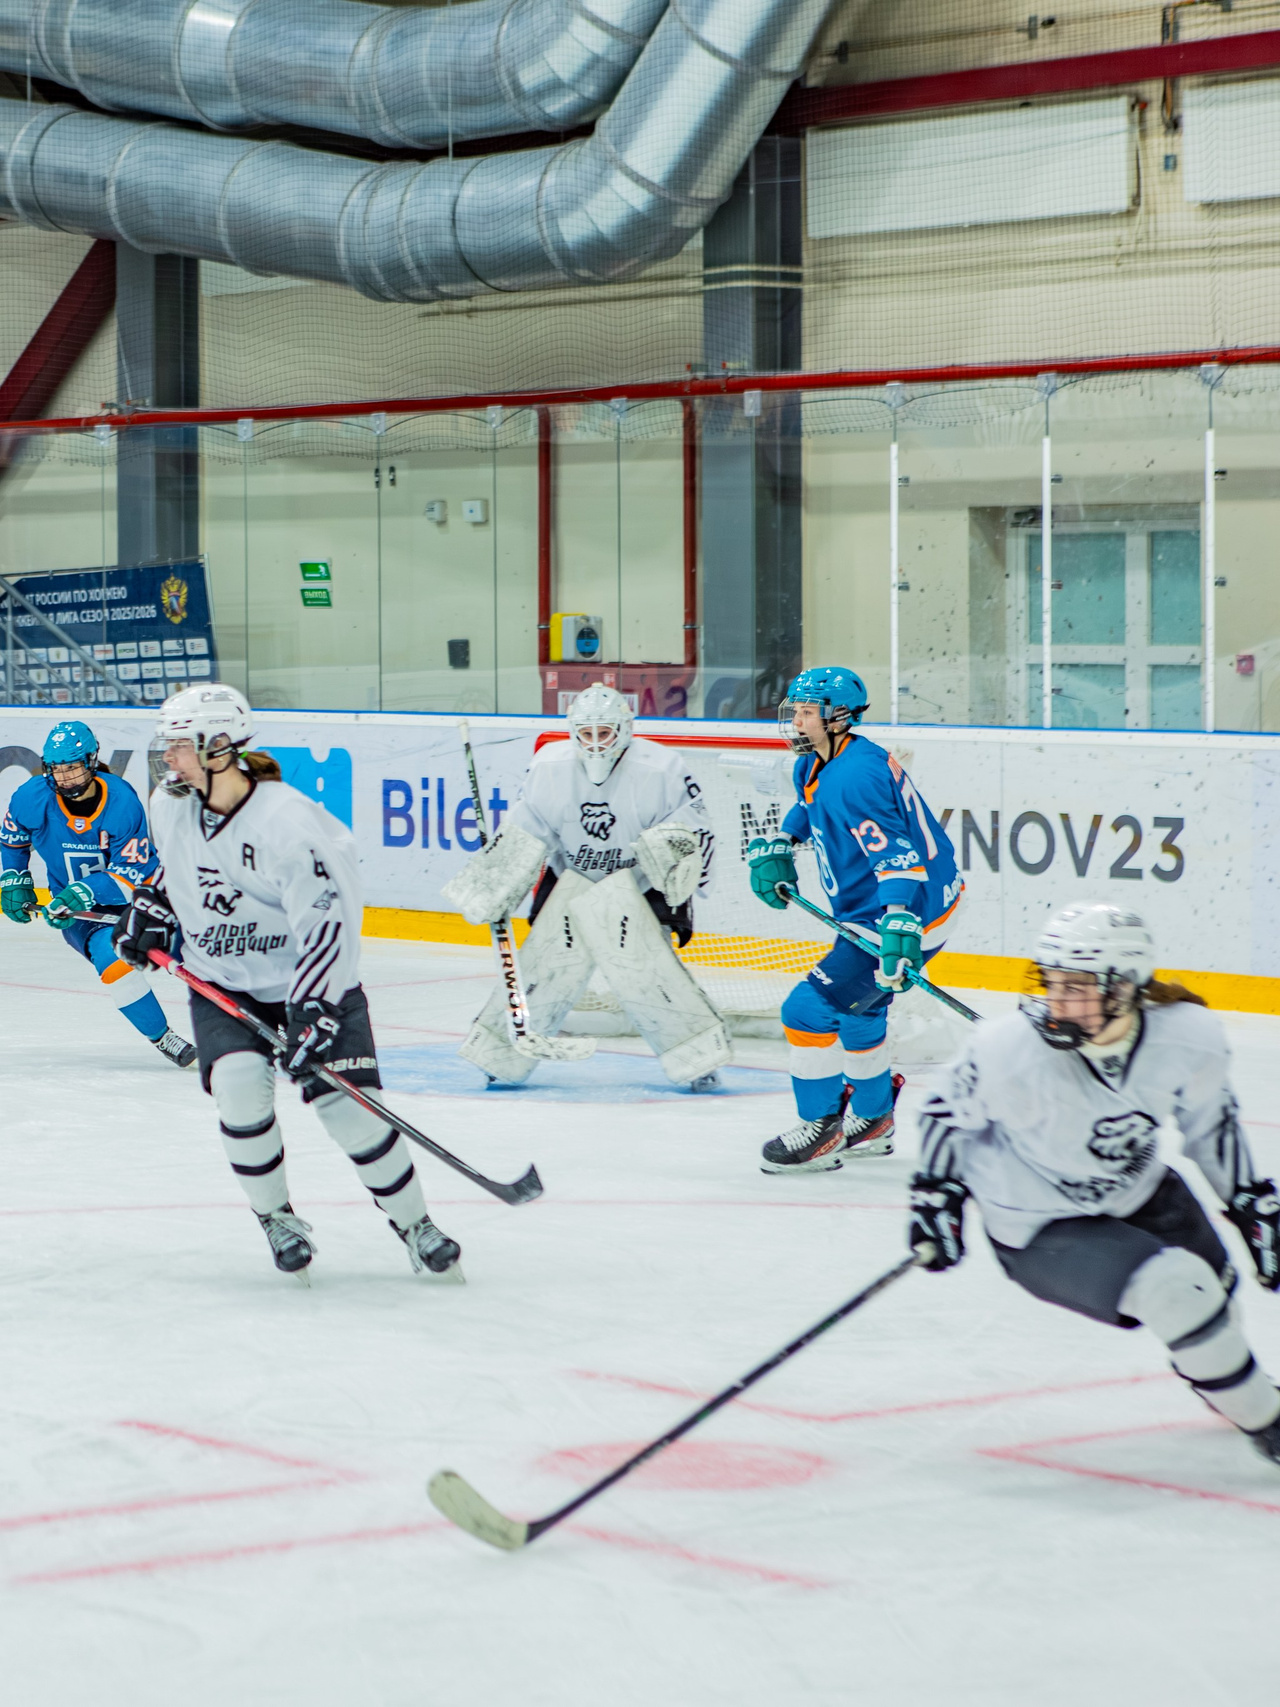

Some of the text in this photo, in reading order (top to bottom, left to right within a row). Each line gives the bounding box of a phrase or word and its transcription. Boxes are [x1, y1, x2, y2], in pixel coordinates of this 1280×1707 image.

[111, 604, 157, 621] 2025/2026
[121, 837, 150, 864] 43
[850, 819, 889, 858] 13
[133, 896, 180, 928] CCM
[494, 919, 526, 1041] HERWOO
